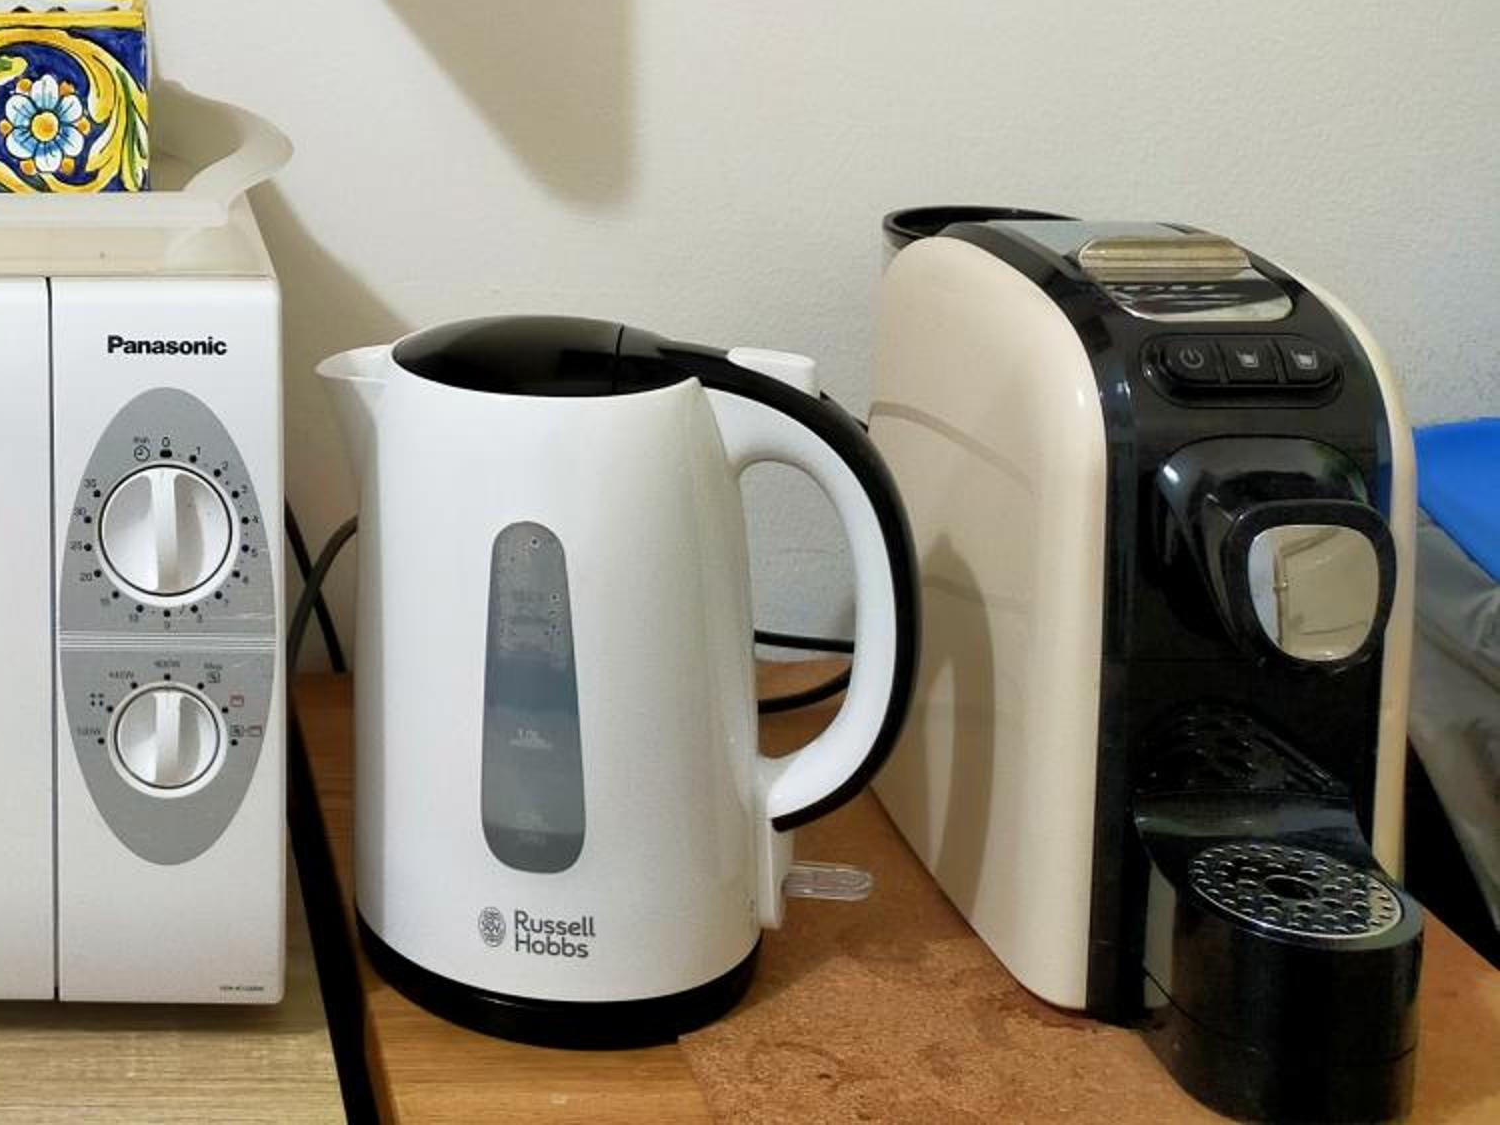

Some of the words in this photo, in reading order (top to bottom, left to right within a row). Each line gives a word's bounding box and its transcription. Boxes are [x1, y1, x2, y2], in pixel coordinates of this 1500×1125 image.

[107, 335, 227, 356] Panasonic
[515, 909, 596, 937] Russell
[515, 932, 589, 958] Hobbs
